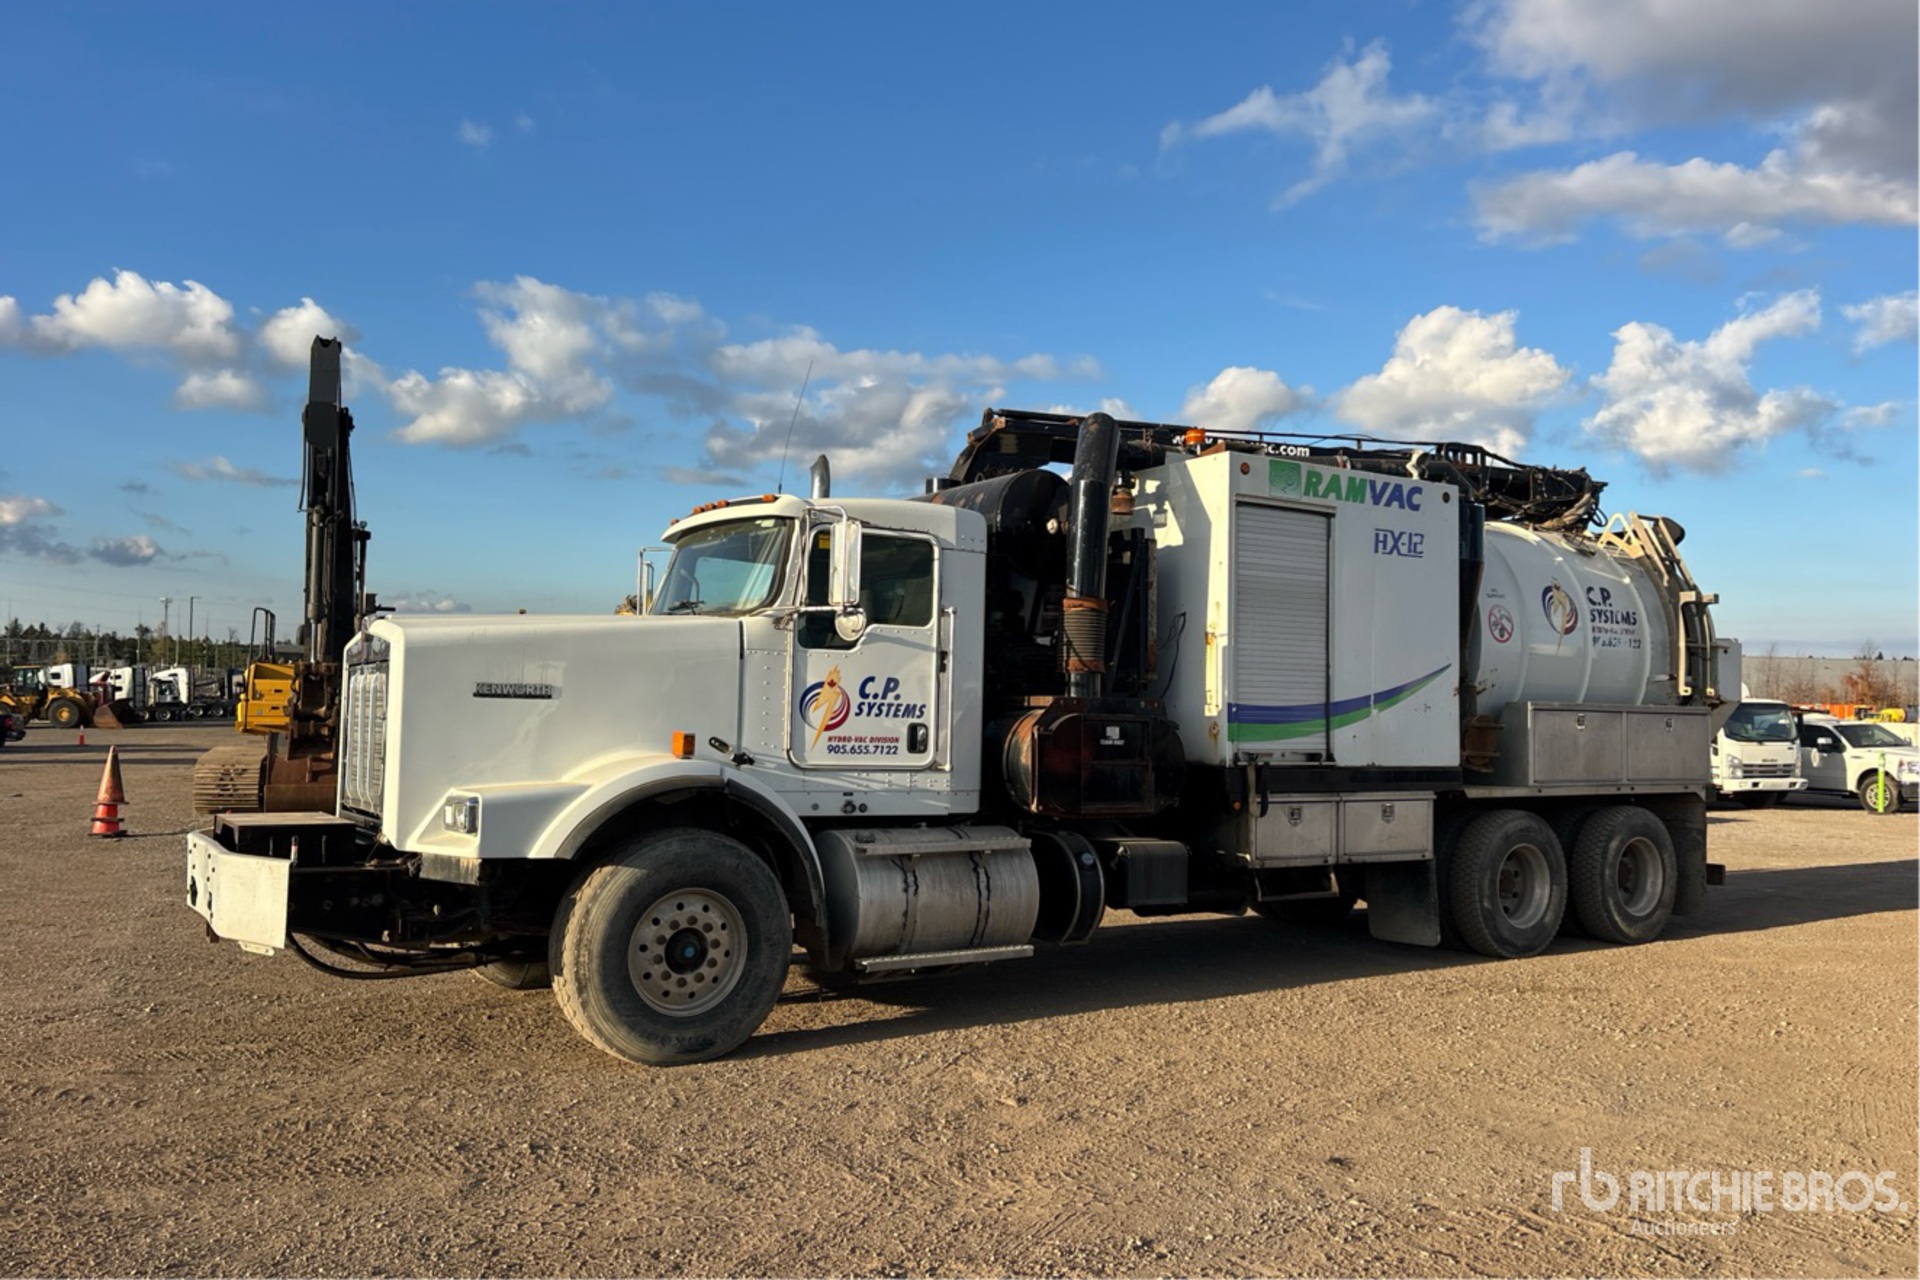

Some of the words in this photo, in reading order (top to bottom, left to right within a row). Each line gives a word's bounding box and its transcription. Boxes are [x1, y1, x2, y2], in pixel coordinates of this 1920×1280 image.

[1303, 469, 1424, 512] RAMVAC
[1374, 528, 1425, 558] HX-12
[475, 682, 552, 696] KENWORTH
[858, 675, 902, 701] C.P.
[854, 701, 927, 719] SYSTEMS
[826, 744, 899, 755] 905.655.7122
